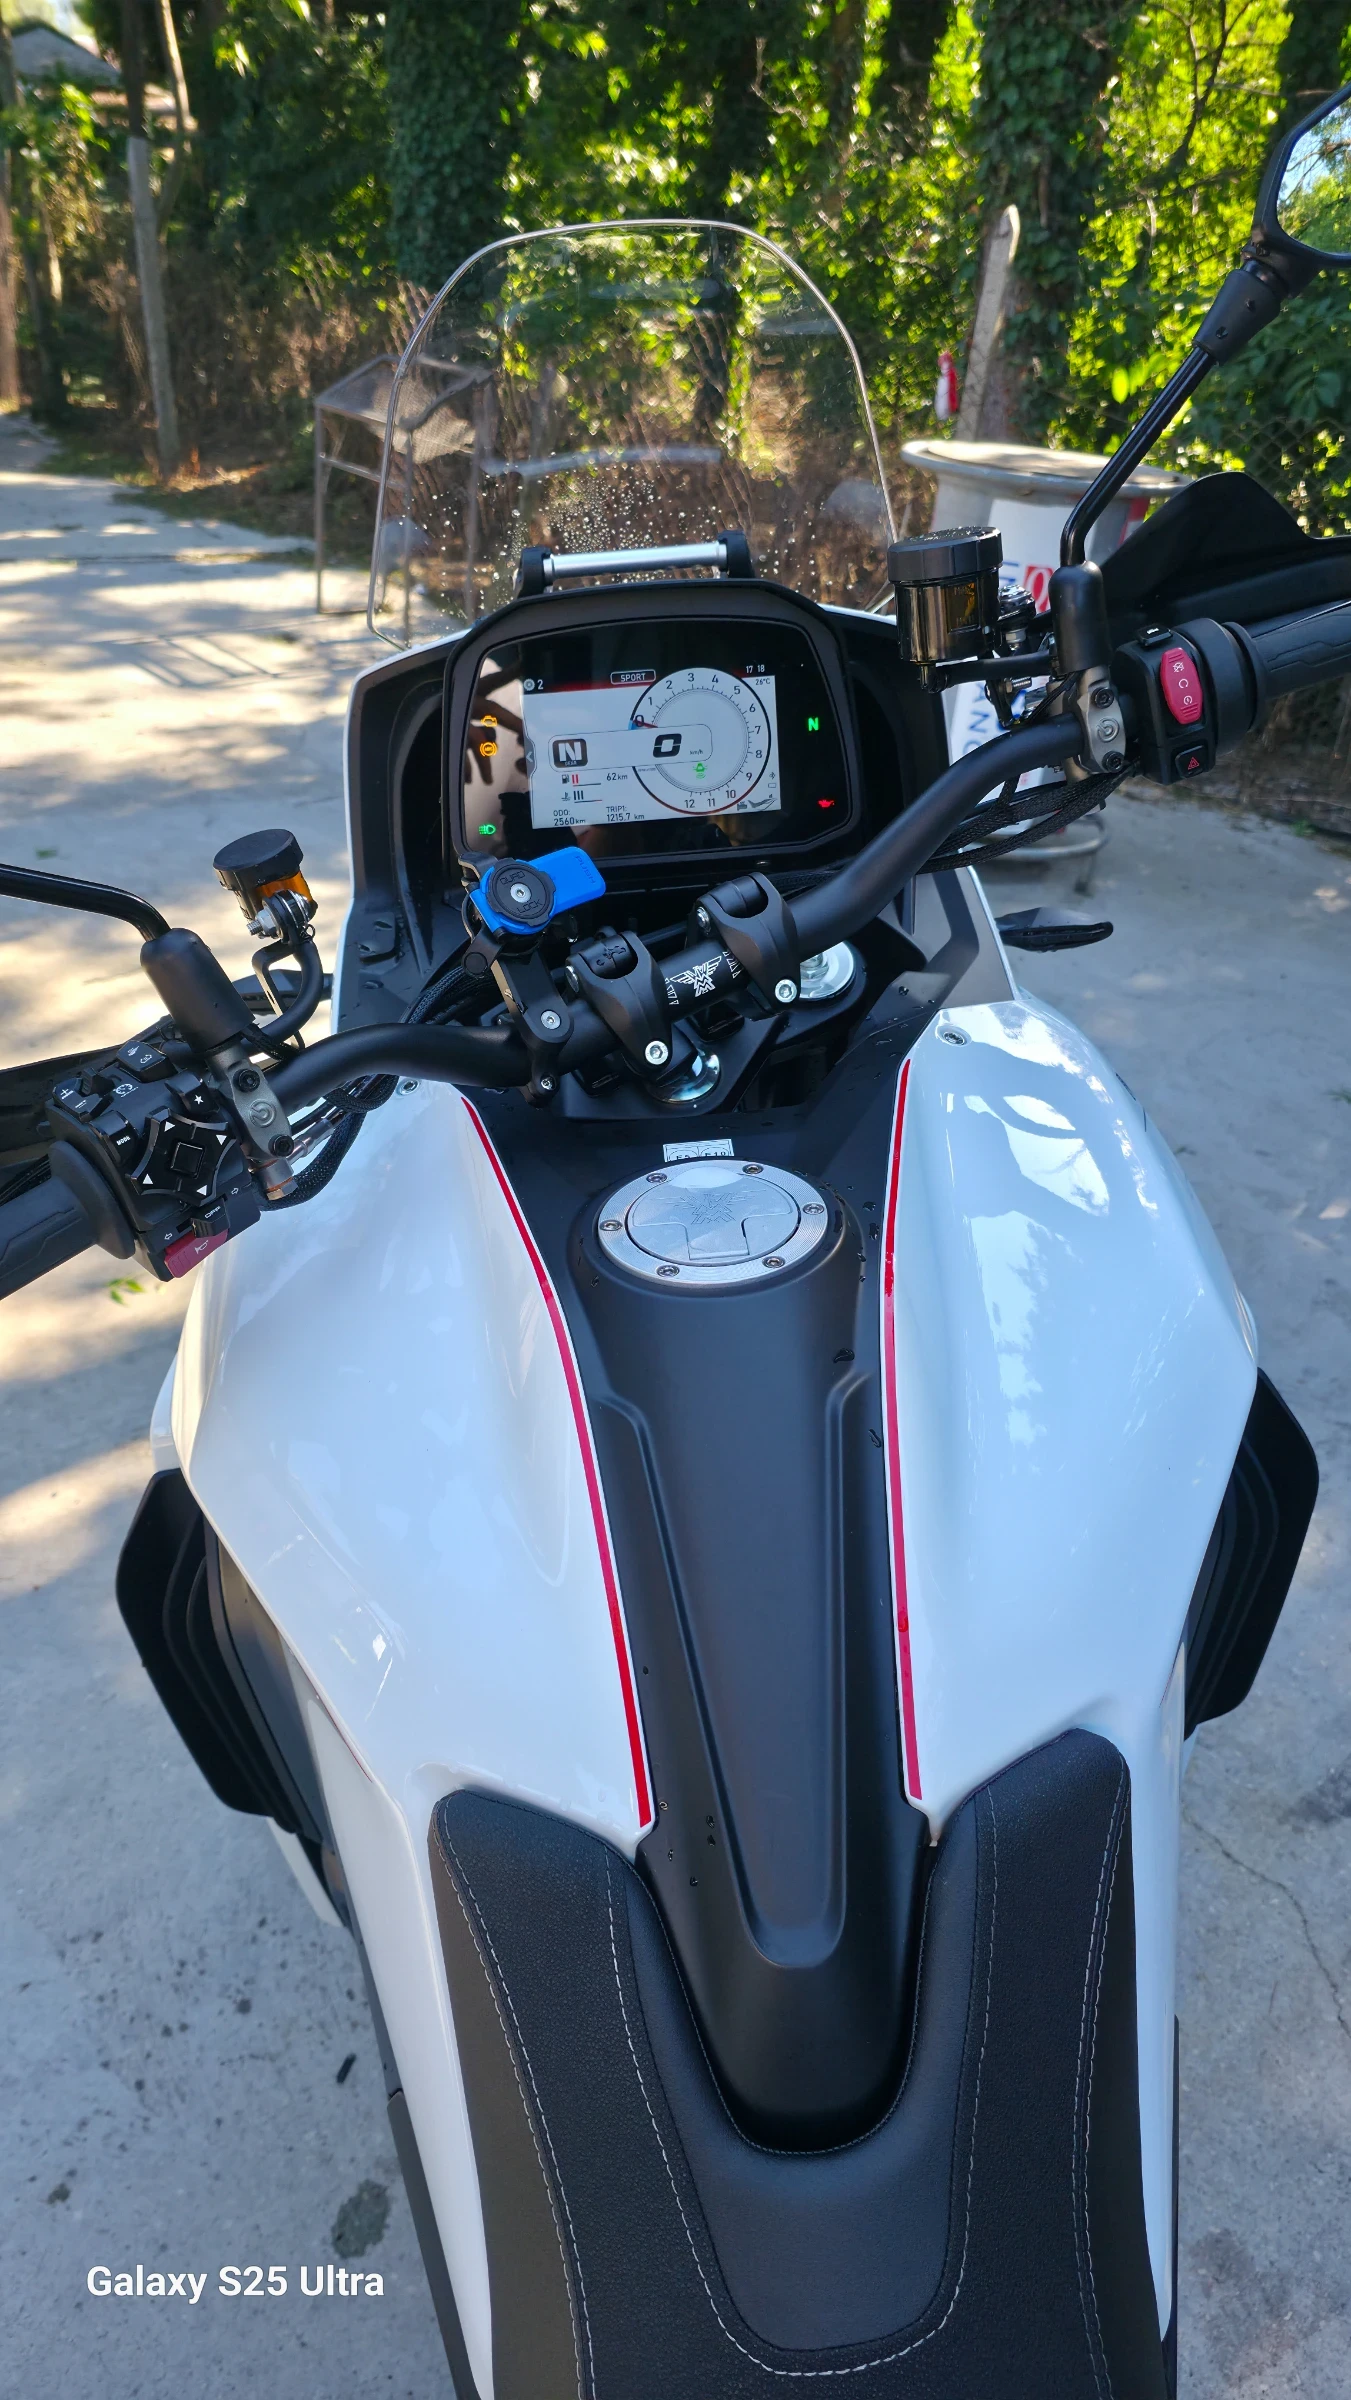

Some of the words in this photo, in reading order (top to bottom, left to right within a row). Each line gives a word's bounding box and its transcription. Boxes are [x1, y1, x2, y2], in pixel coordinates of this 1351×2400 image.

[620, 672, 646, 683] SPORT
[687, 672, 695, 682] 3
[711, 674, 719, 683] 4
[755, 678, 771, 686] 26°C
[537, 679, 544, 690] 2
[665, 680, 673, 690] 2
[733, 685, 741, 695] 5
[647, 696, 653, 706] 1
[749, 703, 756, 713] 6
[634, 714, 645, 727] 0
[808, 717, 819, 731] N
[754, 725, 762, 735] 7
[652, 733, 682, 758] 0
[558, 741, 583, 762] N
[755, 750, 763, 759] 8
[745, 772, 753, 781] 9
[725, 789, 736, 799] 10
[684, 799, 695, 809] 12
[707, 798, 716, 807] 11
[553, 809, 571, 817] ODO:
[606, 805, 627, 813] TRIP1:
[573, 855, 597, 884] PUSH
[500, 870, 526, 885] QUAD
[517, 898, 544, 914] LOCK
